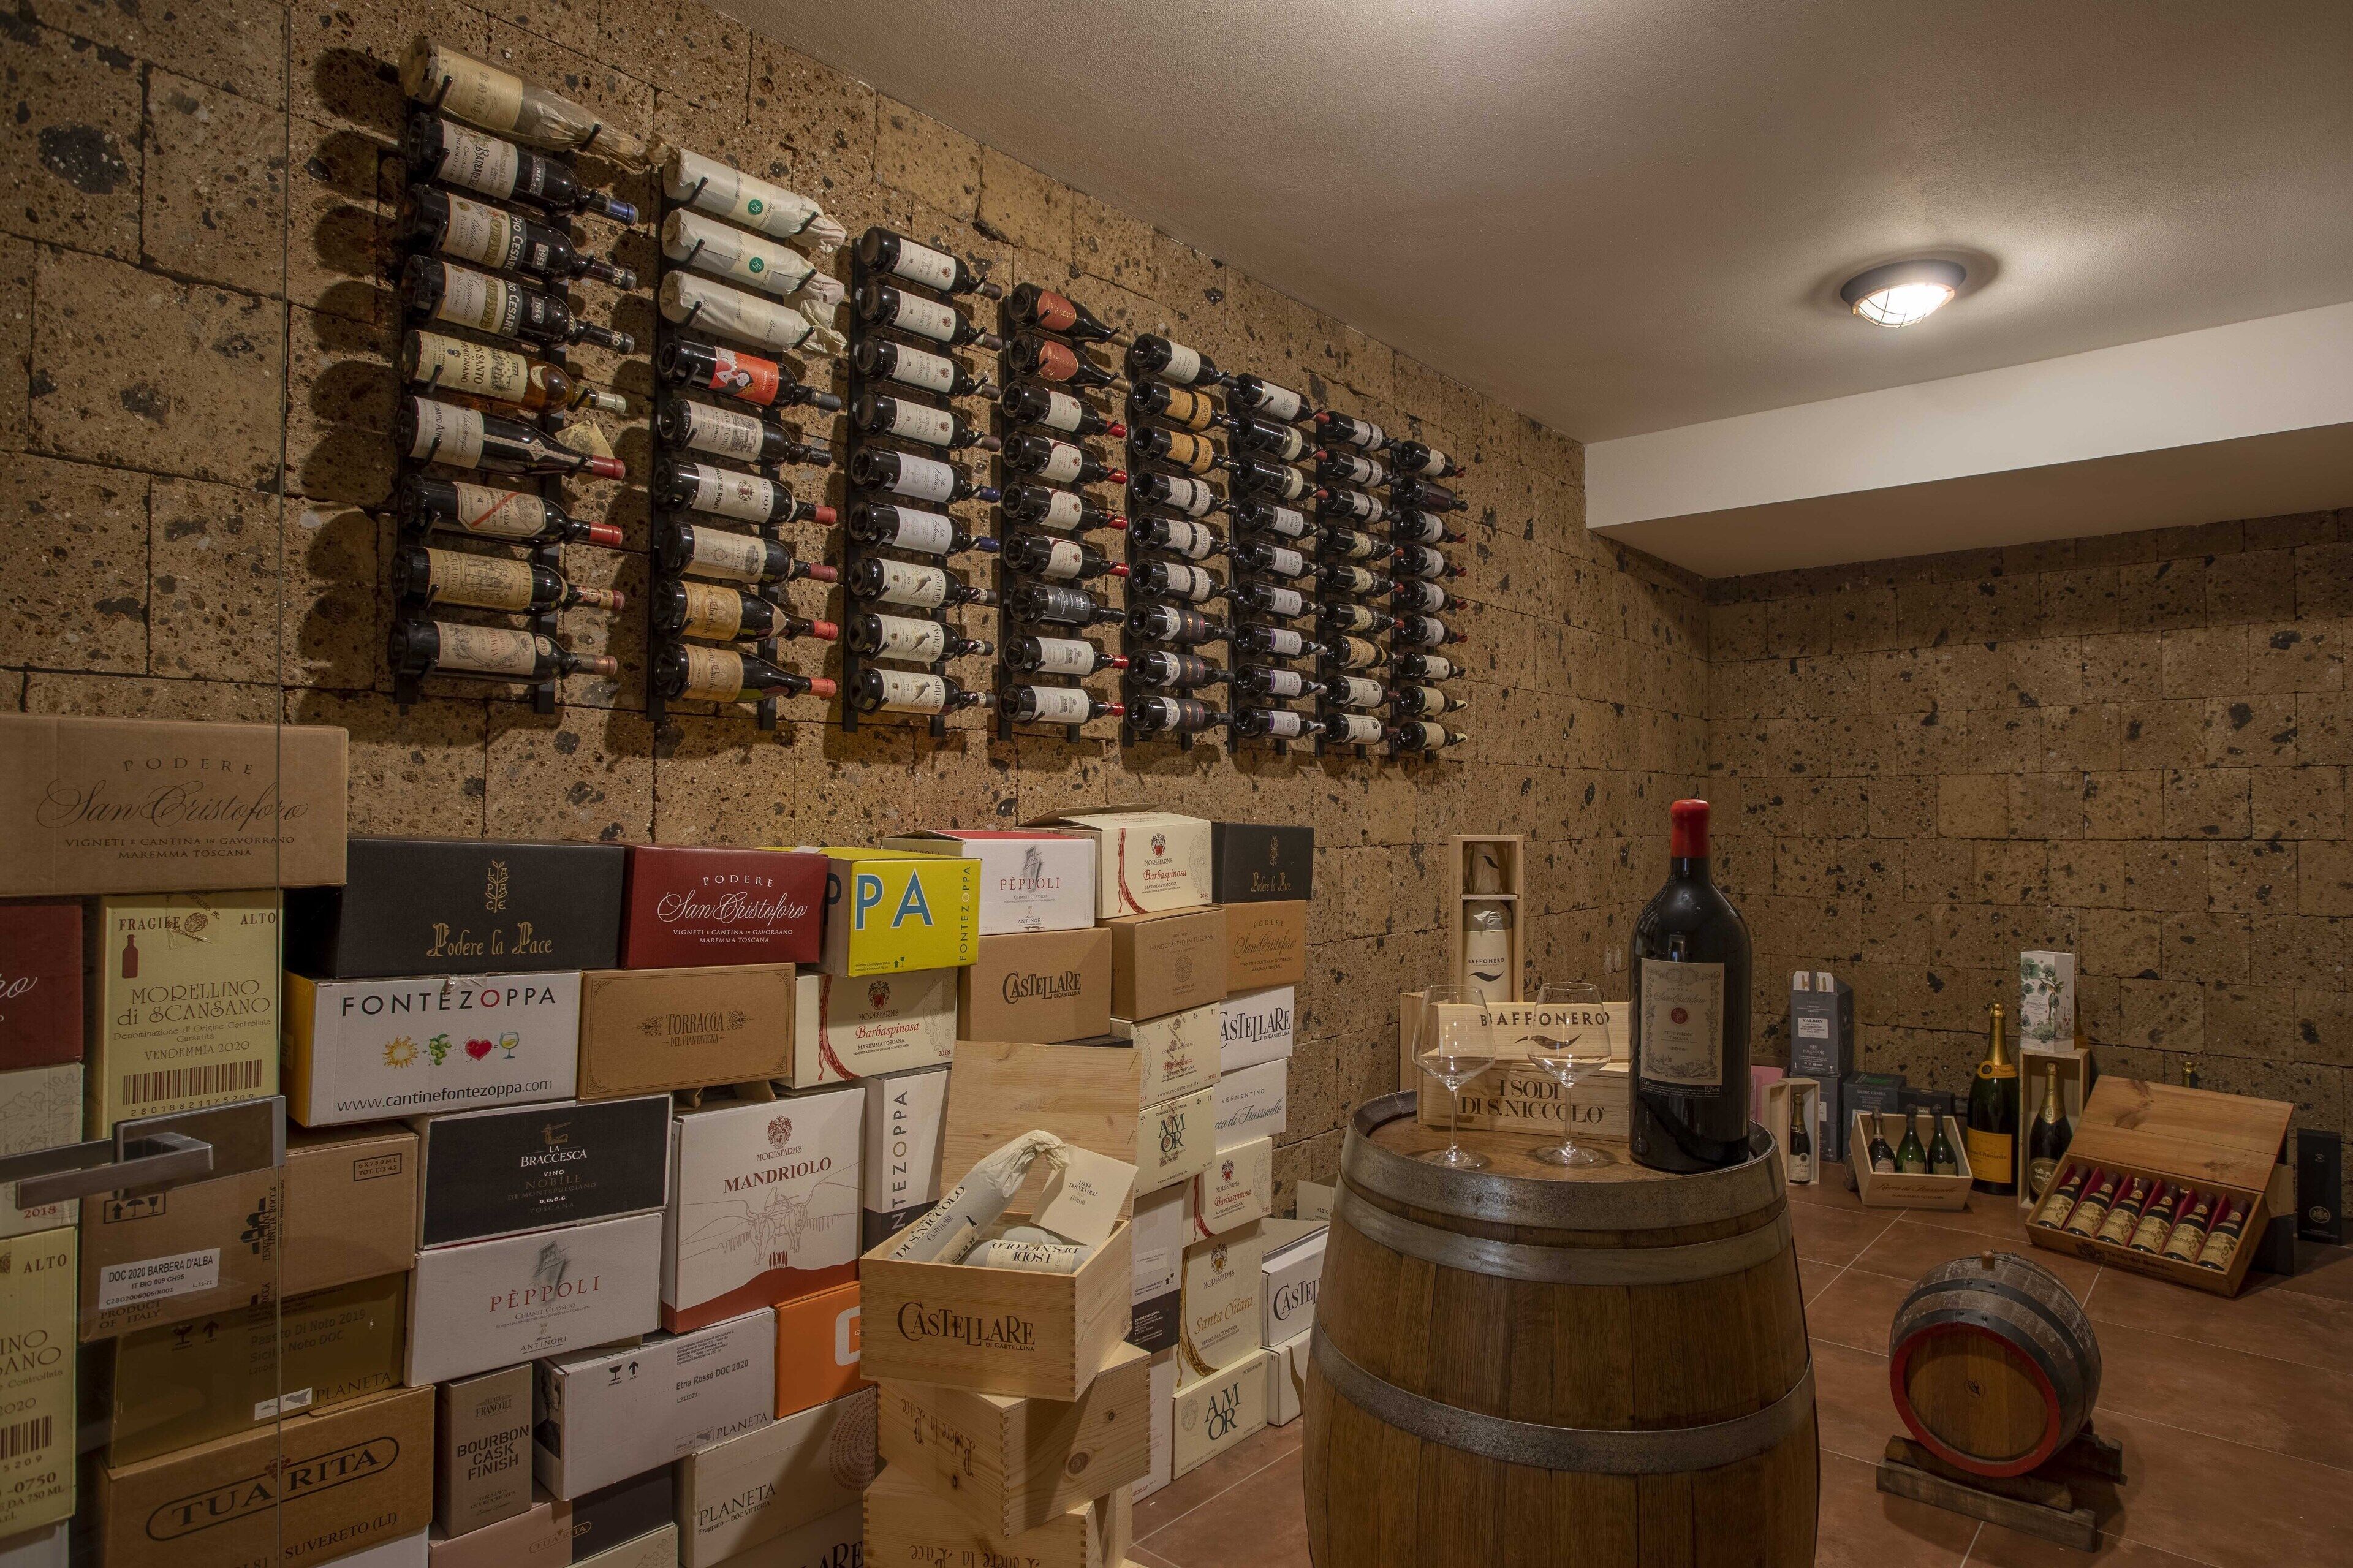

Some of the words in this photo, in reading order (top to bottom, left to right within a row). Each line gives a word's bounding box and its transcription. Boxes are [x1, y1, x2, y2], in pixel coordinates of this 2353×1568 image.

[510, 216, 523, 231] PIO
[504, 235, 523, 270] CESARE
[537, 248, 546, 267] 1953
[614, 267, 624, 284] PIO
[502, 294, 520, 332] CESARE
[460, 341, 471, 382] ARMIGNANO
[474, 354, 485, 384] SANTO
[500, 491, 510, 526] ORDEAUX
[712, 492, 722, 510] ROGER
[123, 757, 254, 775] PODERE
[36, 779, 144, 828] San
[139, 781, 308, 831] Cristoforo
[65, 838, 125, 847] VIGNETI
[140, 837, 202, 847] CANTINA
[219, 836, 295, 845] GAVORRANO
[118, 850, 188, 859] MAREMMA
[194, 849, 252, 857] TOSCANA
[703, 874, 775, 888] PODERE
[1000, 876, 1061, 891] PÈPPOLI
[1143, 868, 1188, 882] Barbaspinosa
[657, 890, 716, 923] San
[711, 891, 809, 927] Cristoforo
[958, 866, 971, 961] FONTEZOPPA
[118, 916, 181, 931] FRAGILE
[240, 912, 276, 926] ALTO
[1253, 919, 1284, 929] PODERE
[426, 922, 485, 957] Podere
[491, 928, 505, 956] la
[512, 921, 554, 955] Pace
[1150, 939, 1186, 952] HANDCRAFTED
[1193, 933, 1215, 944] TUSCANY
[131, 979, 260, 1006] MORELLINO
[1002, 971, 1083, 1006] CASTELLARE
[117, 1008, 139, 1026] di
[148, 996, 271, 1024] SCANSANO
[342, 985, 556, 1017] FONTEZOPPA
[113, 1027, 180, 1041] Denominazione
[194, 1023, 225, 1036] Origine
[227, 1018, 272, 1030] Controllata
[175, 1032, 215, 1043] Garantita
[855, 1022, 920, 1040] Barbaspinosa
[1268, 1031, 1290, 1040] CASTELLINA
[143, 1044, 216, 1062] VENDEMMIA
[217, 1040, 251, 1055] 2020
[857, 1041, 883, 1050] MAREMMA
[336, 1078, 553, 1113] www.cantinefontezoppa.com
[1221, 1089, 1265, 1103] VERMENTINO
[1510, 1080, 1562, 1101] SODI
[1460, 1096, 1483, 1115] DI
[521, 1149, 588, 1168] BRACCESCA
[525, 1175, 582, 1191] NOBILE
[722, 1157, 833, 1194] MANDRIOLO
[521, 1181, 597, 1199] MONTEPULCIANO
[1214, 1189, 1252, 1208] Barbaspinosa
[23, 1206, 56, 1219] 2018
[530, 1202, 575, 1214] TOSCANA
[23, 1254, 67, 1274] ALTO
[108, 1270, 127, 1283] DOC
[128, 1267, 146, 1280] 2020
[148, 1260, 185, 1277] BARBERA
[186, 1255, 213, 1269] D'ALBA
[140, 1280, 153, 1289] BIO
[167, 1274, 184, 1284] CH95
[490, 1276, 600, 1313] PÈPPOLI
[99, 1320, 118, 1330] OF
[127, 1310, 162, 1324] ITALY
[100, 1301, 162, 1320] PRODUCT
[515, 1308, 544, 1320] CHIANTI
[545, 1303, 576, 1314] CLASSICO
[1194, 1313, 1224, 1335] Santa
[1224, 1295, 1254, 1321] Chiara
[295, 1324, 307, 1337] Di
[309, 1317, 336, 1333] Noto
[339, 1308, 366, 1325] 2019
[896, 1299, 1037, 1347] CASTELLARE
[288, 1338, 317, 1353] Noto
[319, 1330, 345, 1345] DOC
[520, 1336, 567, 1352] ANTINORI
[994, 1341, 1035, 1352] CASTELLINA
[676, 1379, 692, 1391] Etna
[694, 1371, 714, 1385] Rosso
[715, 1367, 730, 1378] DOC
[732, 1358, 749, 1372] 2020
[316, 1371, 393, 1403] PLANETA
[715, 1412, 768, 1439] PLANETA
[457, 1425, 530, 1458] BOURBON
[473, 1442, 515, 1466] CASK
[468, 1453, 519, 1482] FINISH
[172, 1482, 277, 1528] TUA
[287, 1448, 382, 1492] RITA
[699, 1482, 778, 1527] PLANETA
[699, 1521, 724, 1536] Frappato
[730, 1511, 743, 1523] DOC
[744, 1501, 771, 1517] VITTORIA
[284, 1521, 369, 1559] SUVERETO
[372, 1512, 398, 1531] (LI)
[534, 1536, 559, 1550] TUA
